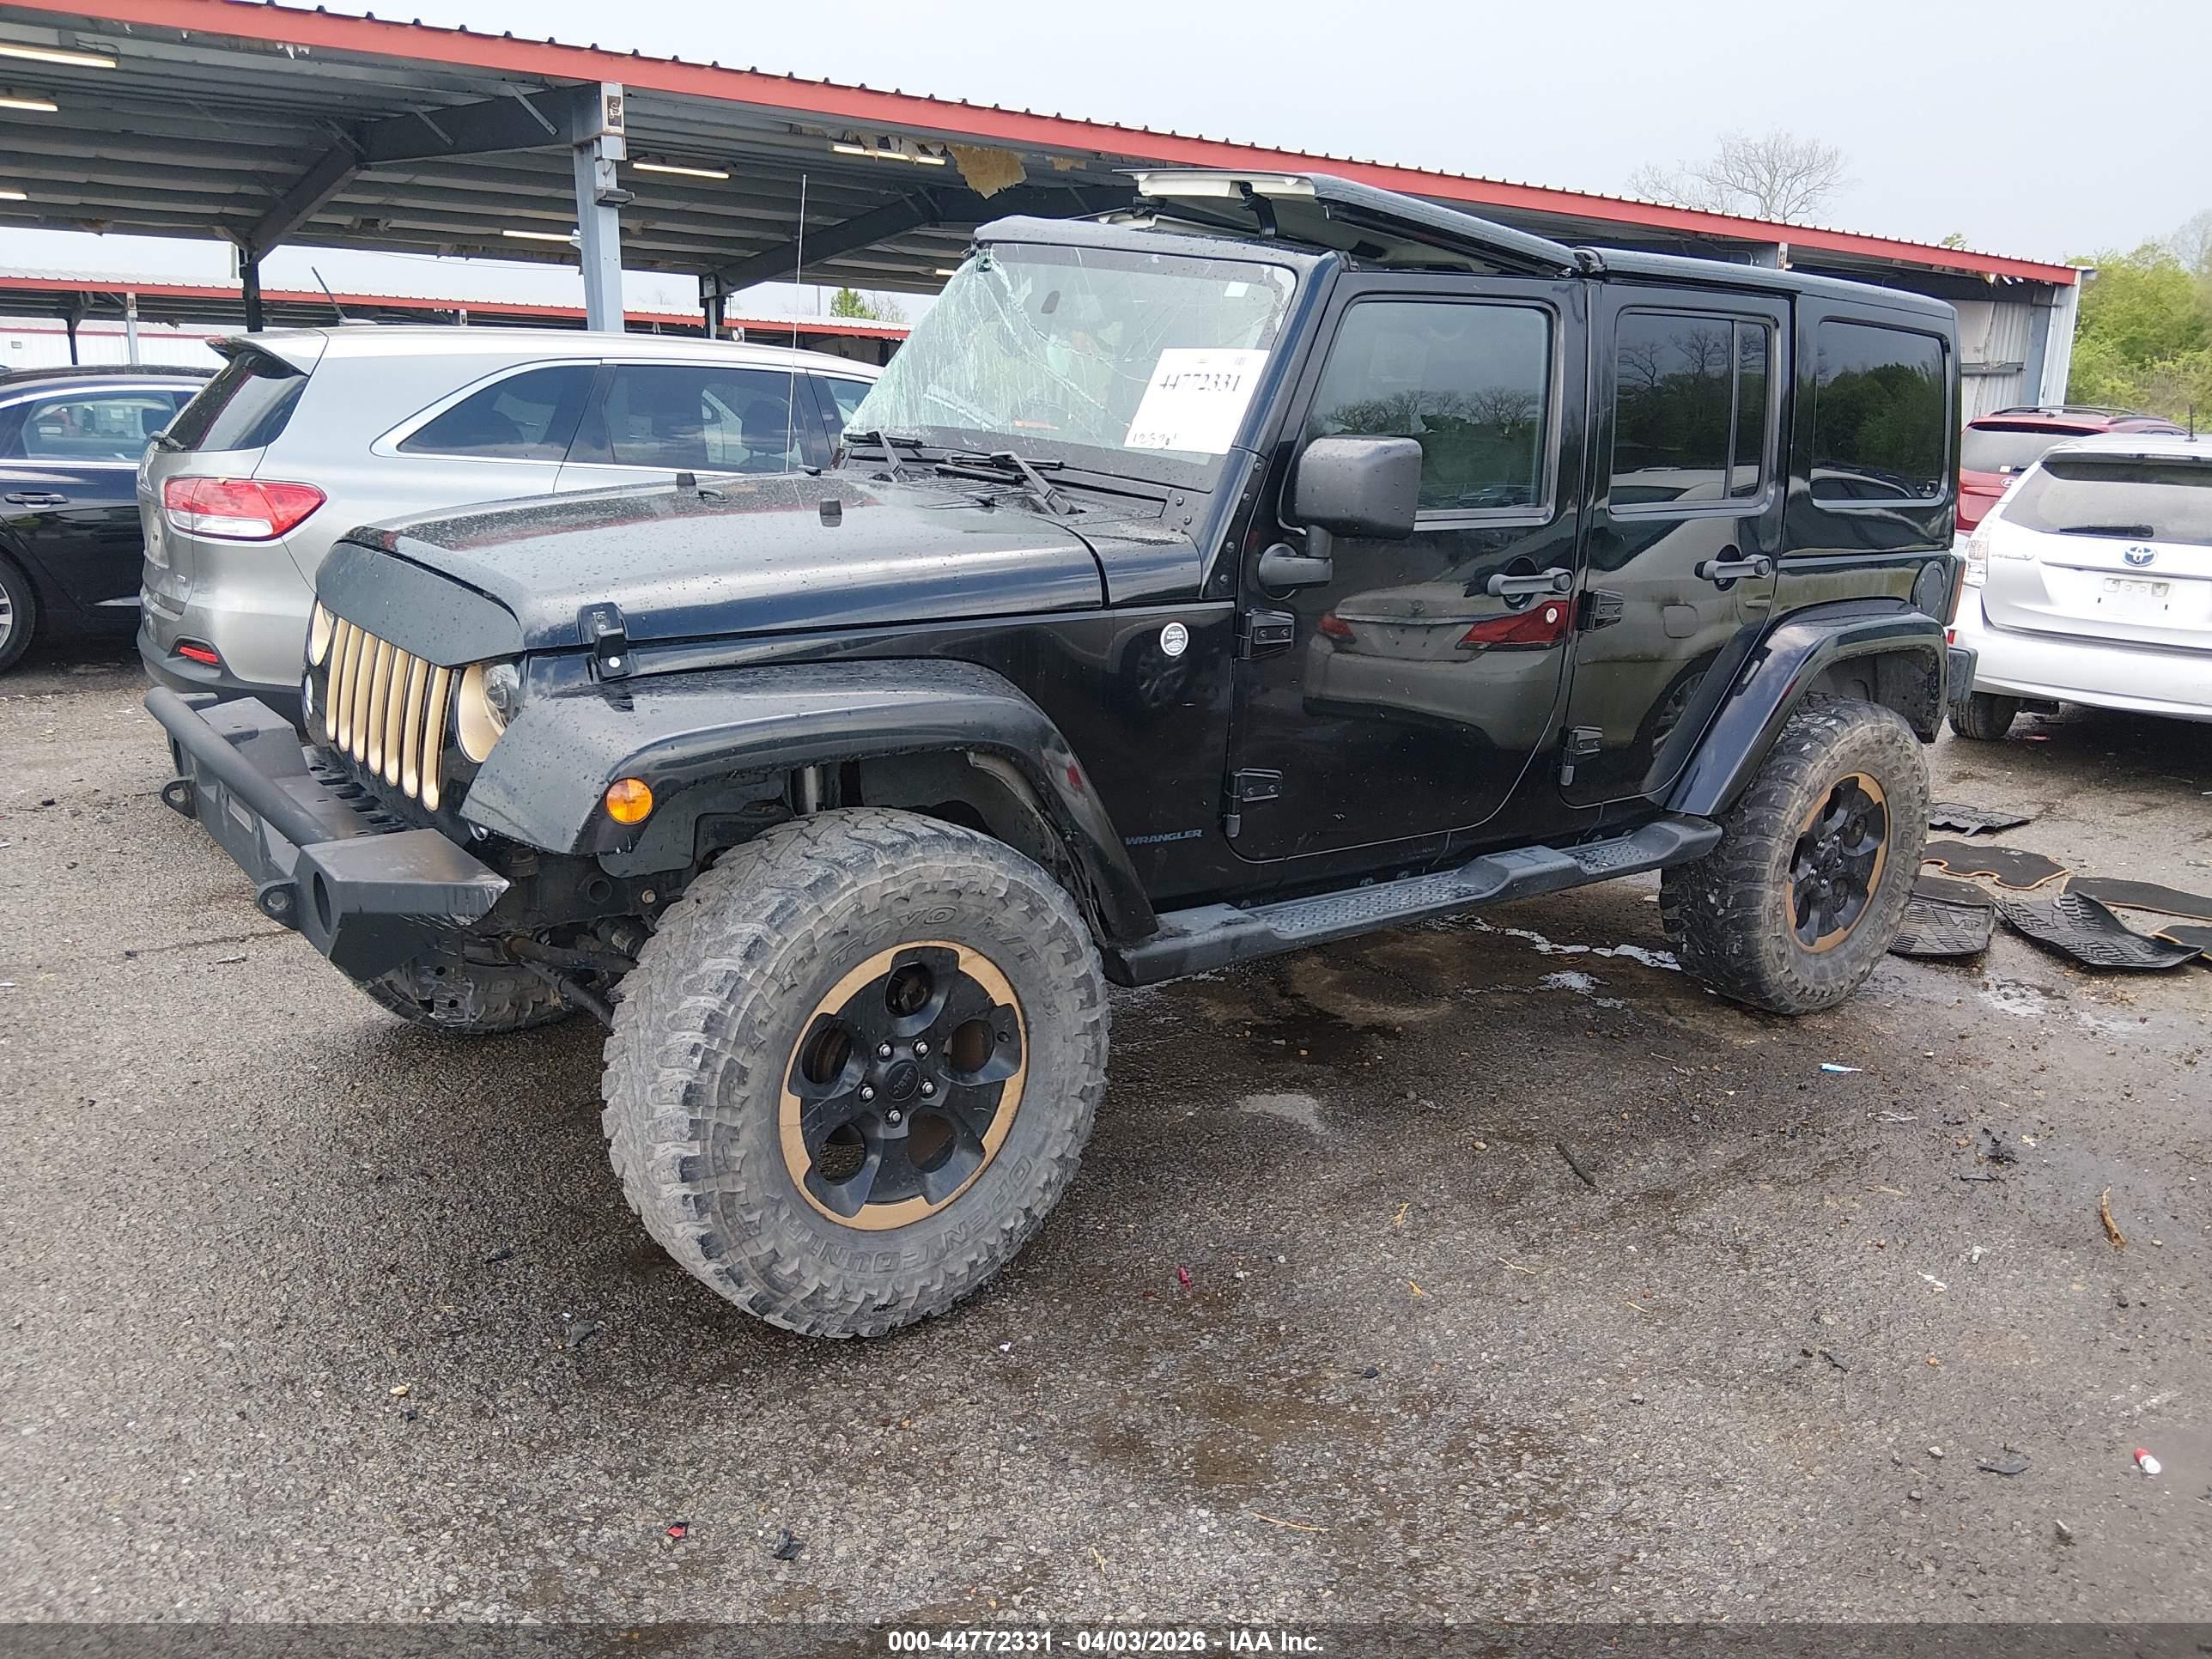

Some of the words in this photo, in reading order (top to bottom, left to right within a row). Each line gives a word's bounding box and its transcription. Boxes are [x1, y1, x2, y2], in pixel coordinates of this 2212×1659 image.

[1158, 373, 1242, 392] 44772331
[1125, 828, 1203, 846] WRANGLER
[830, 905, 958, 967] TOYO
